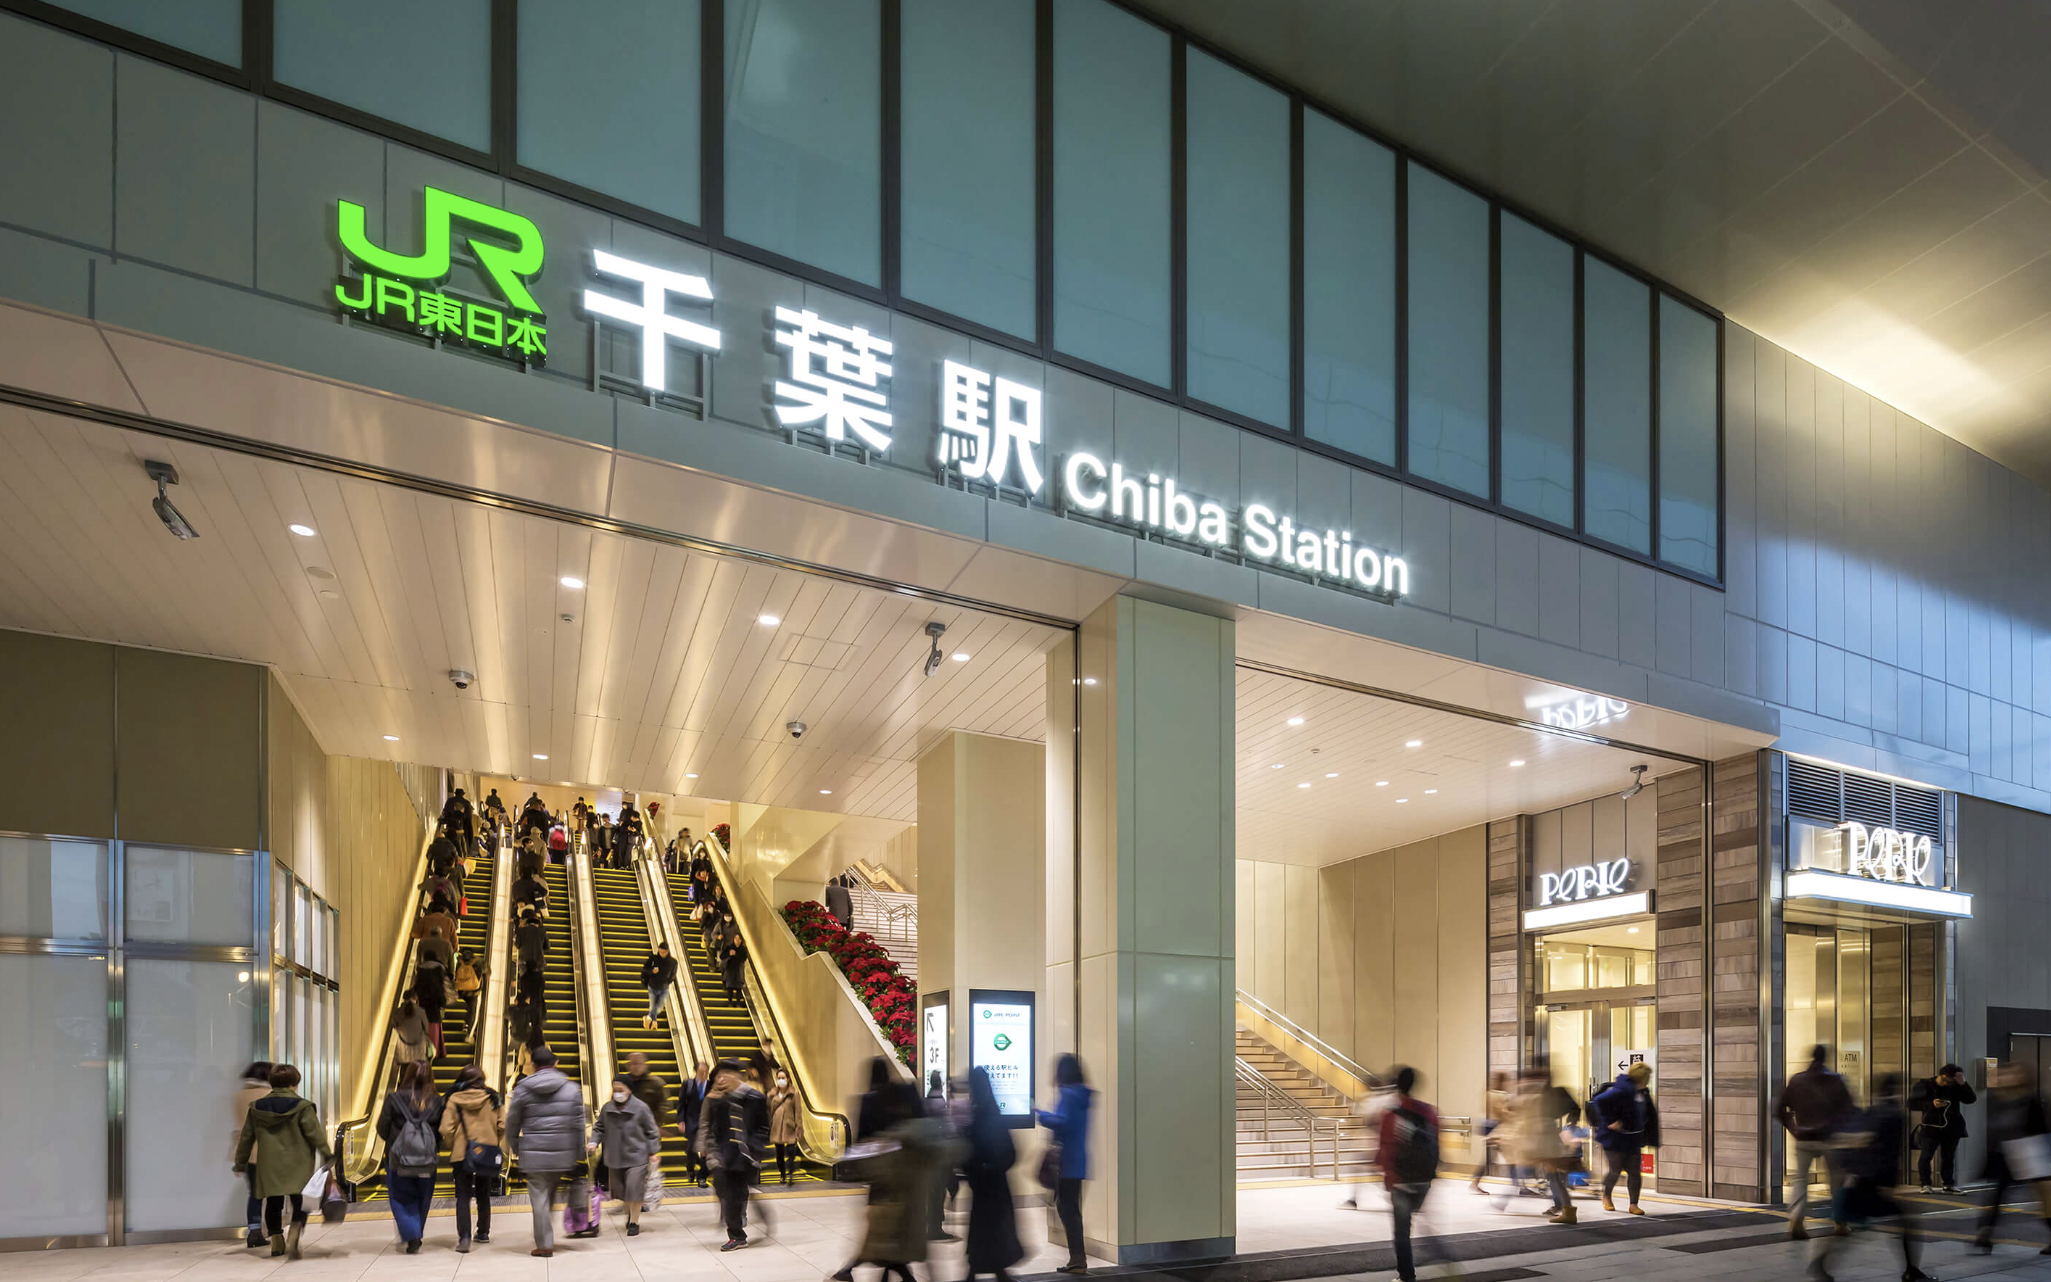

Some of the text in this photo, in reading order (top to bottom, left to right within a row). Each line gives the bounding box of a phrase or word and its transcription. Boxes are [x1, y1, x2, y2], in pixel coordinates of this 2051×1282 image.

[338, 185, 545, 316] JR
[335, 273, 547, 355] JR東日本
[584, 248, 1409, 595] 千葉駅 Chiba Station
[930, 1047, 939, 1064] 3F
[1845, 1053, 1858, 1063] ATM
